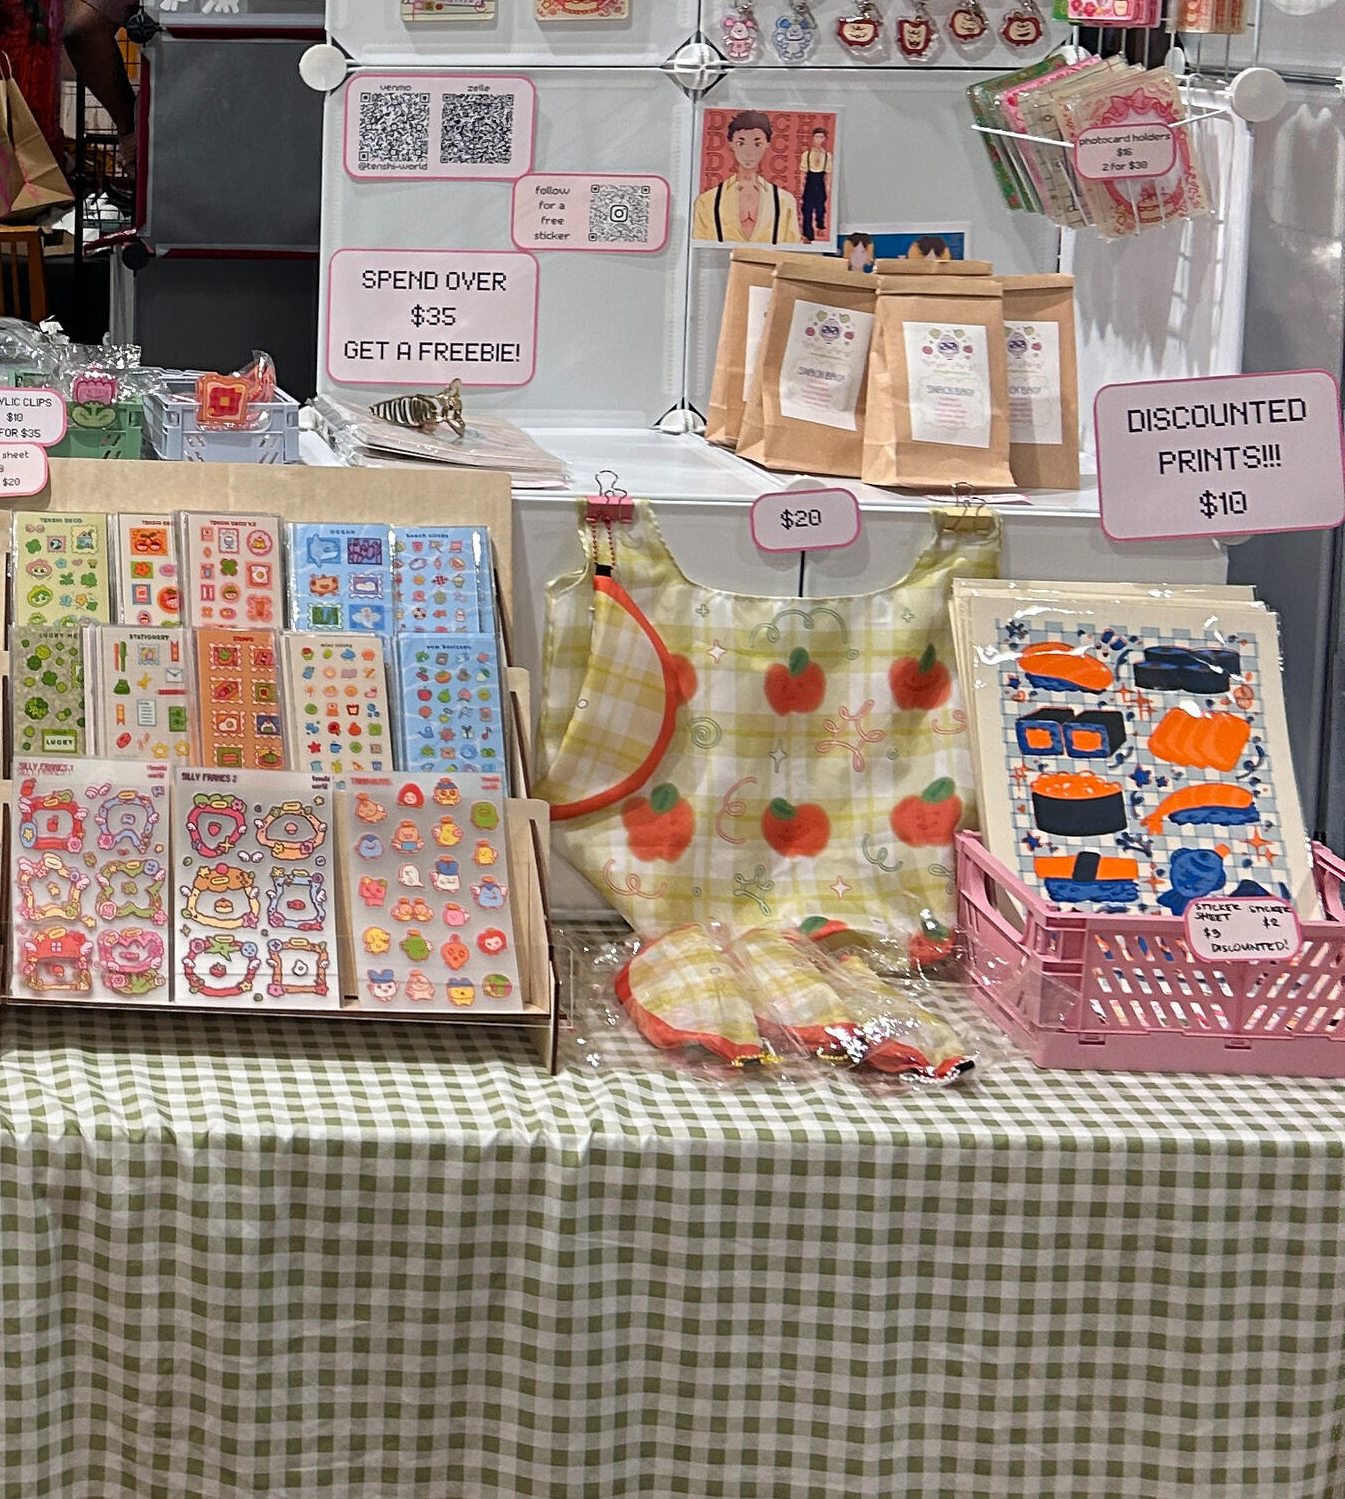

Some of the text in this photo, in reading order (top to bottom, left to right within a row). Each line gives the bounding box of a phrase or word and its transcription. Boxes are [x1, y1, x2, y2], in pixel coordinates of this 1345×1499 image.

[380, 83, 491, 92] venmo zelle
[707, 111, 831, 135] DCHI
[1079, 132, 1172, 147] photocard holders
[1102, 160, 1148, 171] 2 for $30
[535, 185, 571, 195] follow
[539, 200, 566, 210] for a
[541, 216, 565, 225] free
[534, 231, 571, 240] sticker
[362, 270, 507, 292] SPEND OVER
[410, 305, 457, 327] $35
[344, 340, 521, 363] GET A FREEBIE!
[23, 398, 52, 408] CLIPS
[6, 412, 24, 422] $10
[1127, 398, 1307, 433] DISCOUNTED
[20, 428, 41, 439] $35
[2, 450, 30, 459] sheet
[1159, 444, 1282, 475] PRINTS!!!
[2, 477, 21, 487] $20
[1199, 490, 1247, 519] $10
[780, 508, 823, 531] $20
[181, 771, 201, 781] SILLY
[1194, 902, 1243, 912] STICKER
[1249, 905, 1294, 914] STICKER
[1194, 911, 1232, 922] SHEET
[1263, 916, 1281, 929] $2
[1211, 939, 1290, 953] DISCOUNTED!
